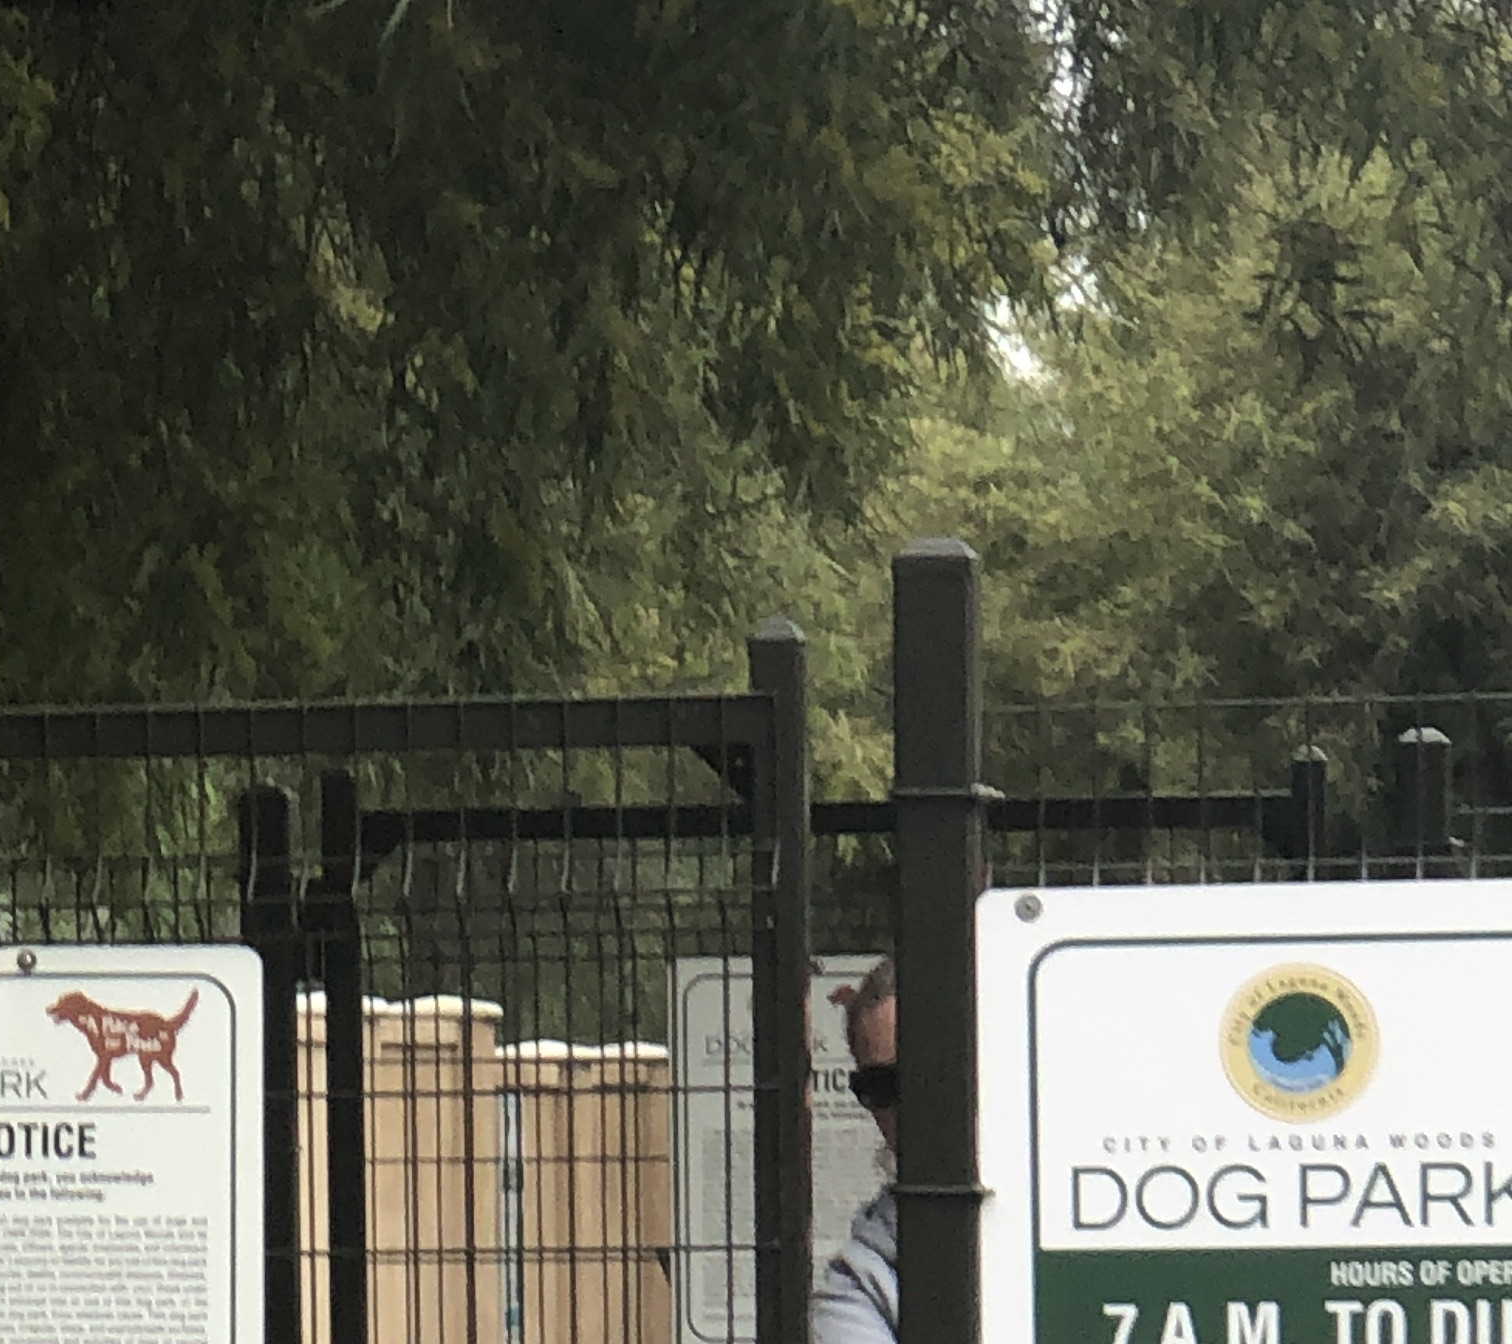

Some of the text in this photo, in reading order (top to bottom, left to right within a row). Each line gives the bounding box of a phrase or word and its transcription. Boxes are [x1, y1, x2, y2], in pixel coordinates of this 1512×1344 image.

[1102, 1132, 1496, 1153] CITY OF LAGUNA WOODS
[1071, 1164, 1268, 1230] DOG
[1330, 1260, 1414, 1287] HOURS
[1419, 1260, 1452, 1286] OF
